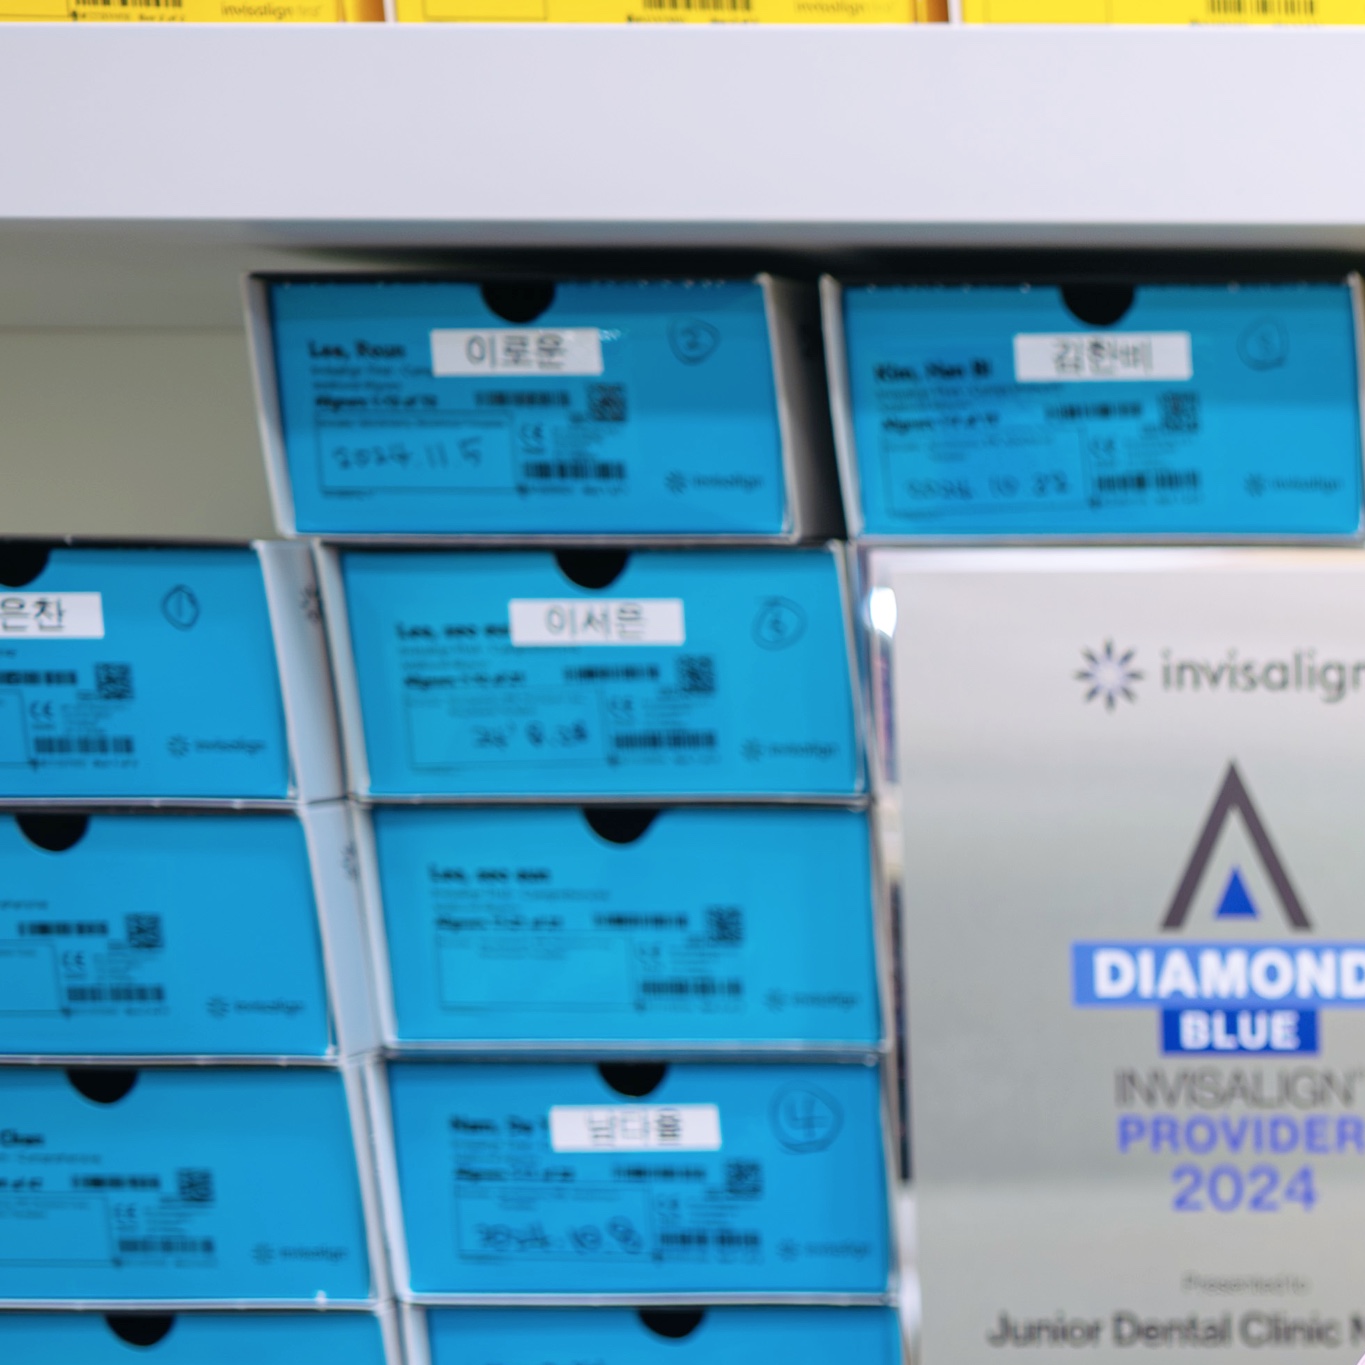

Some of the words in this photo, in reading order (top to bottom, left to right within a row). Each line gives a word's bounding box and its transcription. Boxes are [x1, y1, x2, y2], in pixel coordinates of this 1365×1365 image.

[1178, 1010, 1301, 1051] BLUE
[1114, 1069, 1357, 1108] INVISALIGN
[1171, 1165, 1318, 1212] 2024
[986, 1310, 1102, 1349] Junior
[1111, 1310, 1233, 1348] Dental
[1239, 1310, 1343, 1348] Clinic
